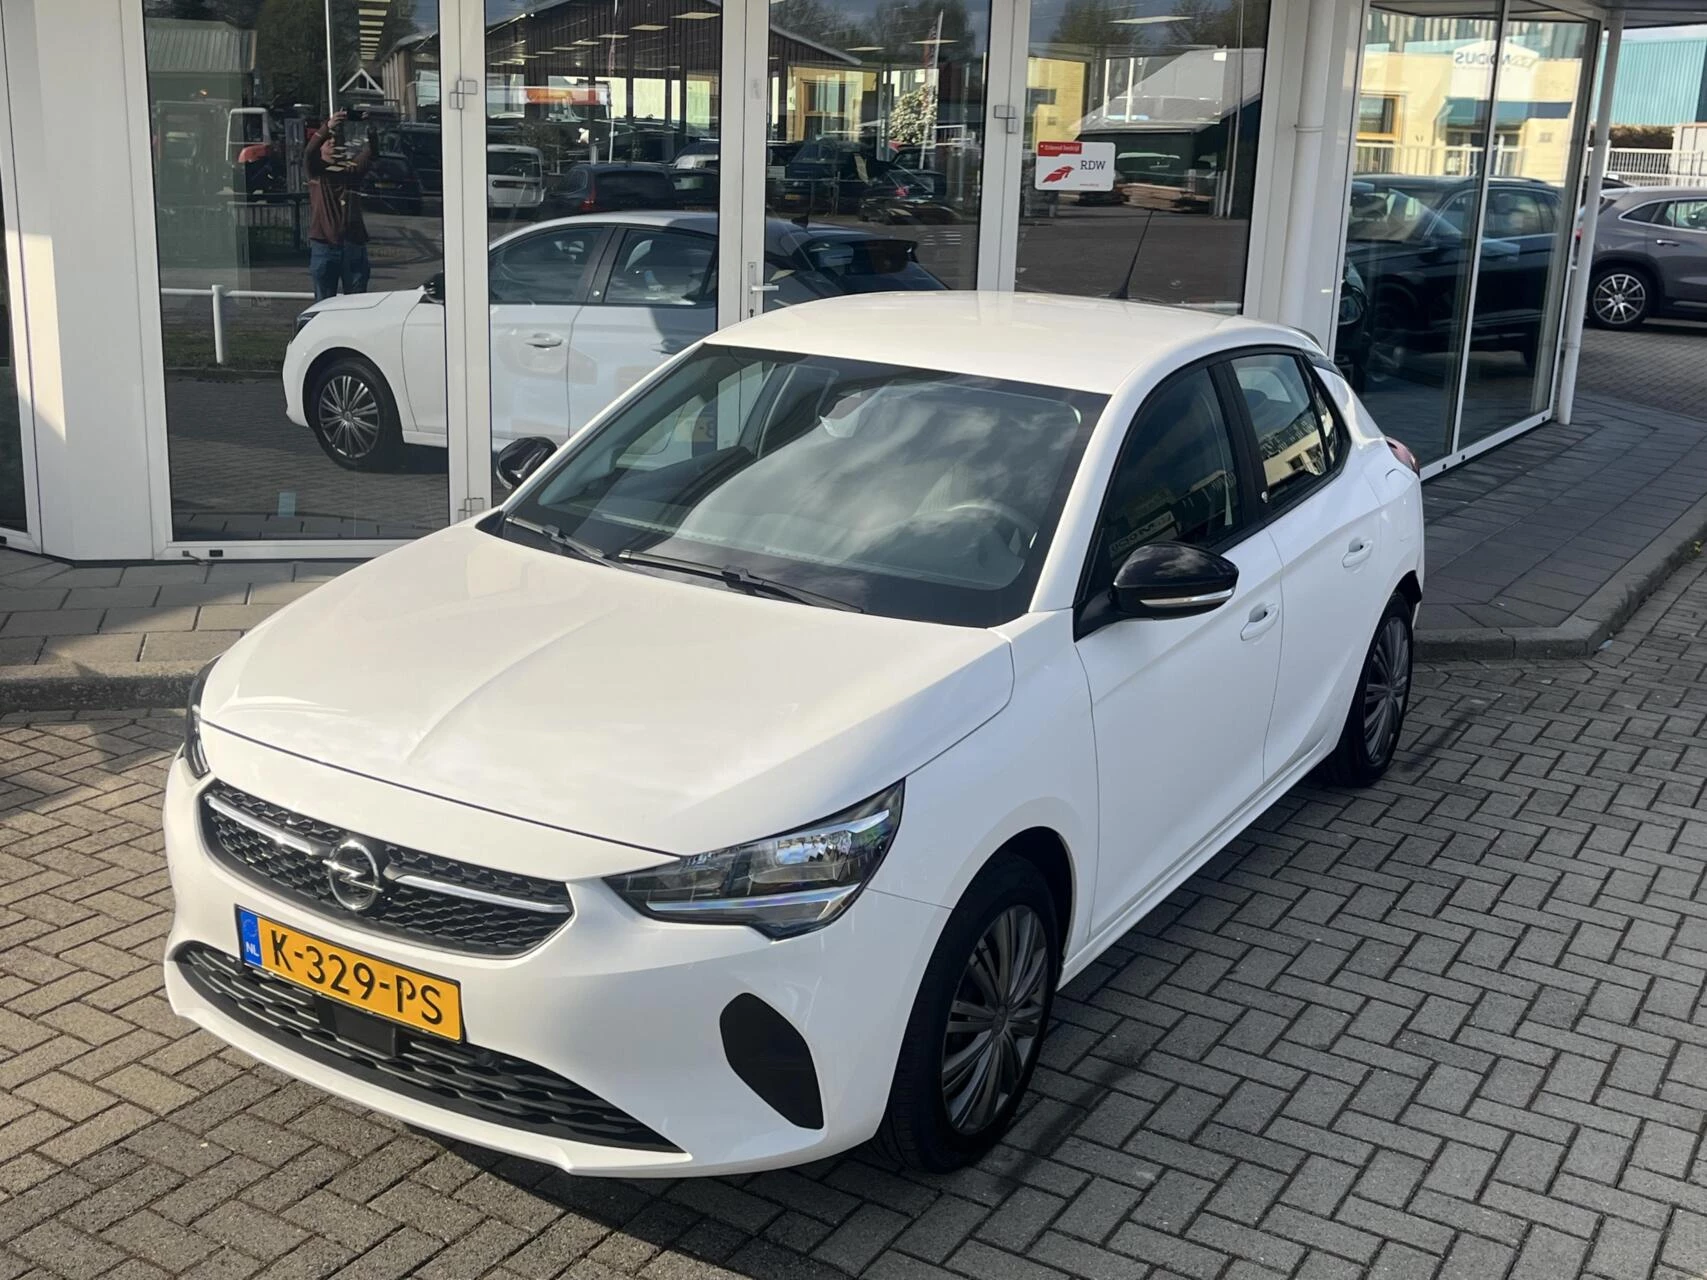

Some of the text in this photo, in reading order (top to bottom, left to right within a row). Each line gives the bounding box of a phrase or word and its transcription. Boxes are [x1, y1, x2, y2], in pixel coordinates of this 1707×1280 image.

[1080, 160, 1106, 170] RDW
[246, 941, 260, 957] NL
[271, 929, 443, 1025] K-329-PS
